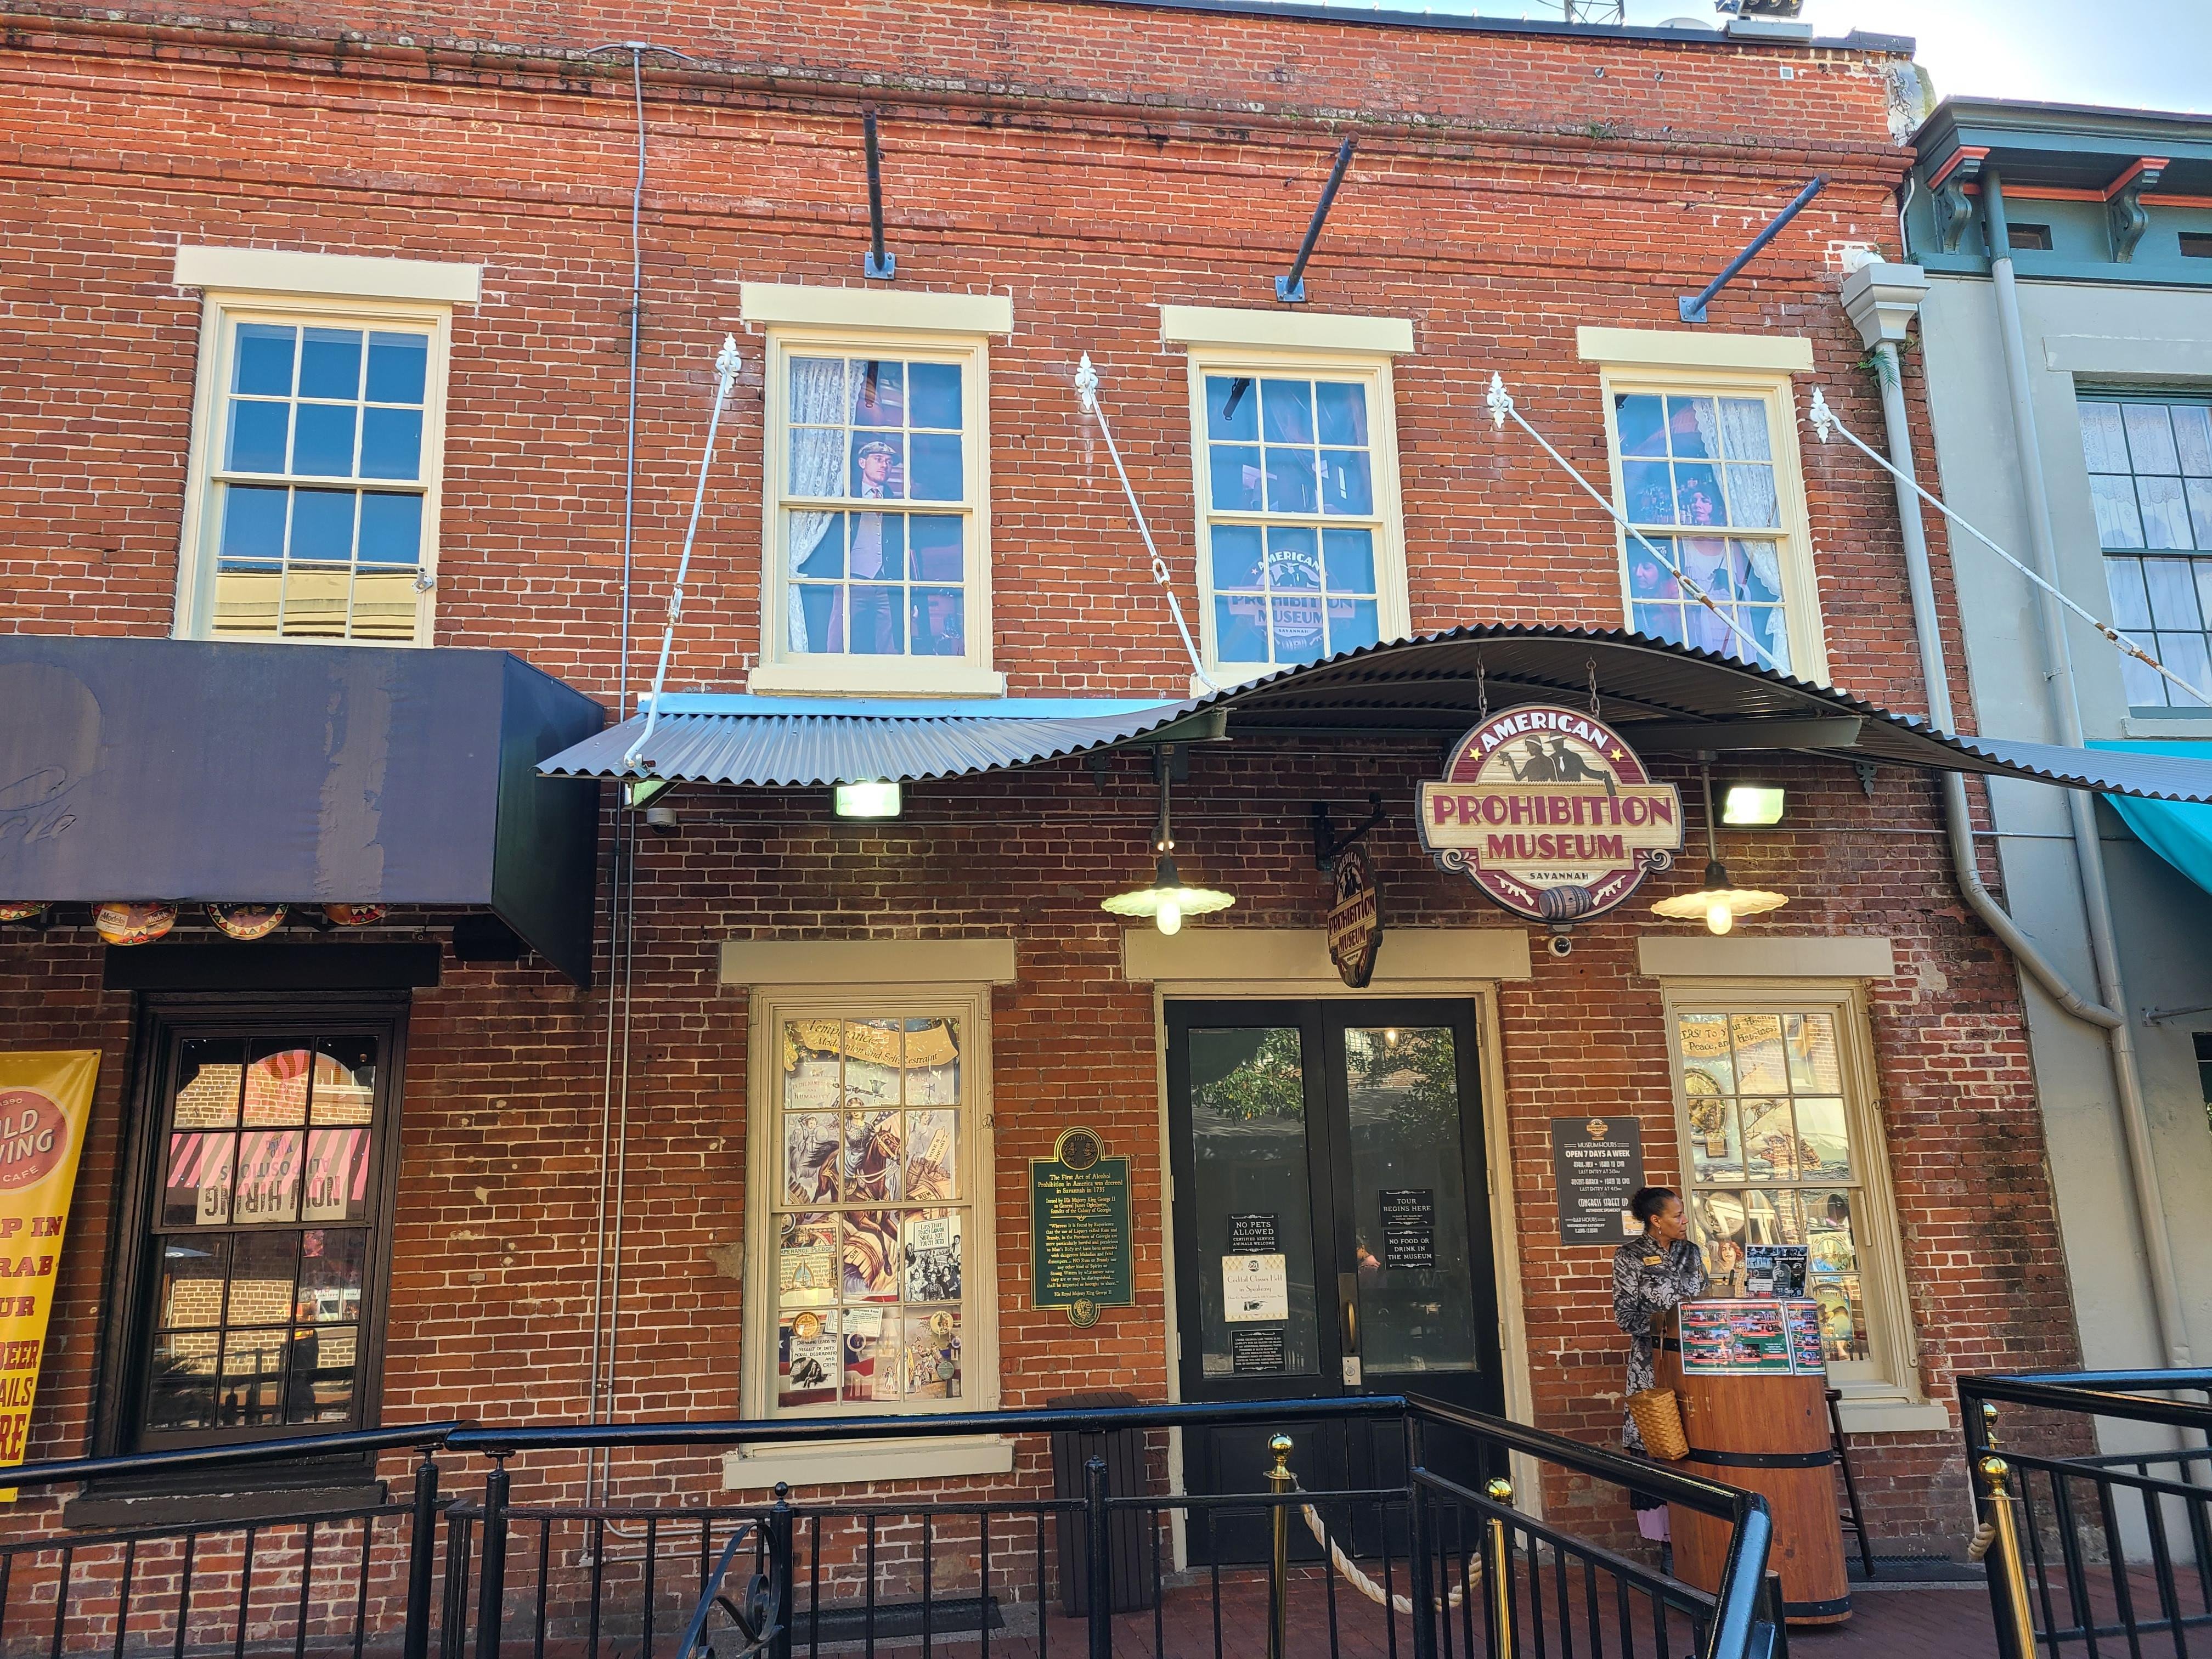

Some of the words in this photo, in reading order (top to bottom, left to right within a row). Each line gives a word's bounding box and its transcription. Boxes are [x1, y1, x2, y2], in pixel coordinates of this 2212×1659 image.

[1258, 551, 1319, 572] AMERICAN
[1232, 595, 1352, 609] PROHIBITON
[1259, 610, 1323, 624] MUSEUM
[1481, 712, 1609, 752] AMERICAN
[1432, 795, 1673, 825] PROHIBITION
[1487, 834, 1624, 859] MUSEUM
[1336, 851, 1361, 886] AMERICAN
[100, 911, 124, 925] Modelo
[146, 911, 168, 924] Modelo
[1329, 893, 1375, 936] PROHIBITION
[1339, 924, 1365, 953] MUSEUM
[1705, 1030, 1717, 1038] To
[1689, 1042, 1717, 1051] Peace,
[0, 1109, 38, 1139] LD
[3, 1165, 40, 1182] CAFE
[221, 1161, 301, 1181] POSITIOS
[205, 1180, 282, 1216] HIRING
[290, 1176, 340, 1210] NOW
[1578, 1198, 1601, 1207] CONGRESS
[1603, 1198, 1620, 1207] STREET
[1621, 1198, 1629, 1206] UP
[31, 1216, 63, 1237] IN
[850, 1249, 859, 1259] GIN
